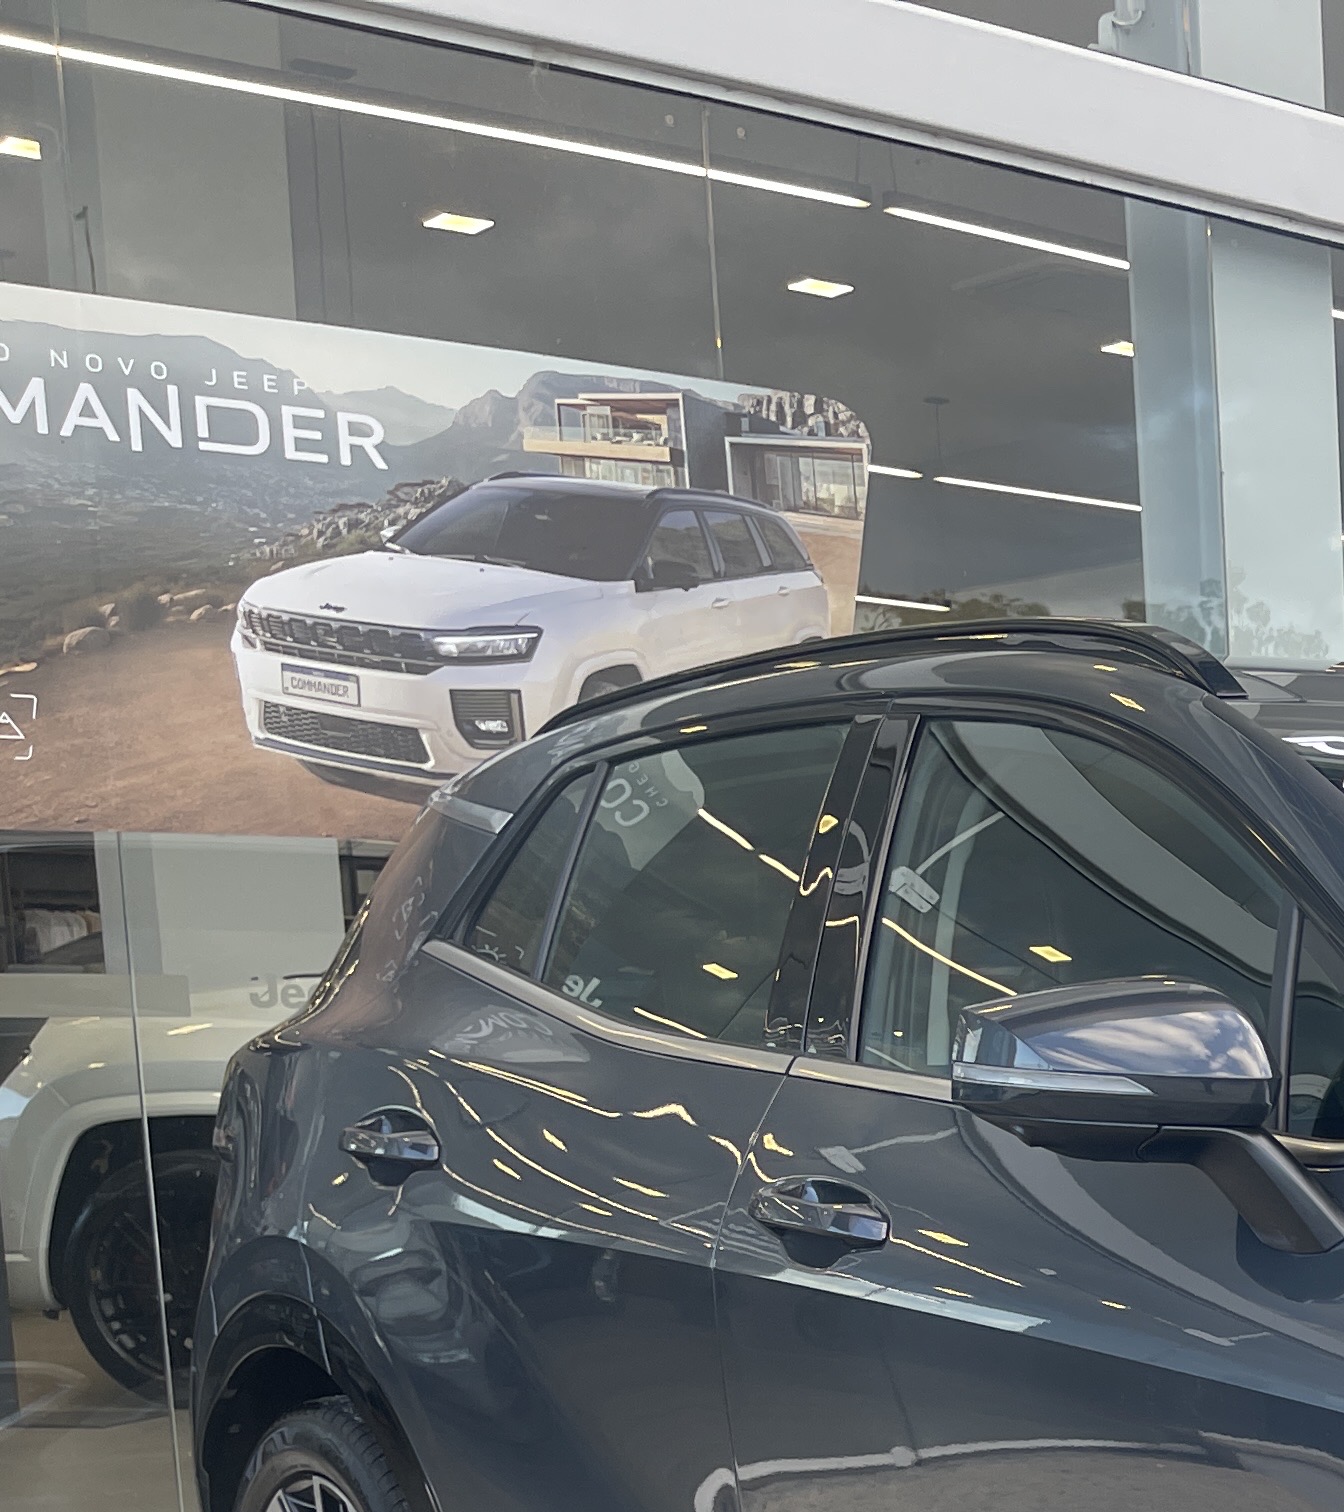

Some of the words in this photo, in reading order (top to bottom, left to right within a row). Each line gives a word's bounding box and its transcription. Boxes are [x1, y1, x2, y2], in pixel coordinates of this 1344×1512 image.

[50, 349, 168, 380] NOVO
[205, 368, 308, 396] JEEP
[0, 376, 390, 471] MANDER
[290, 676, 349, 698] COMMANDER
